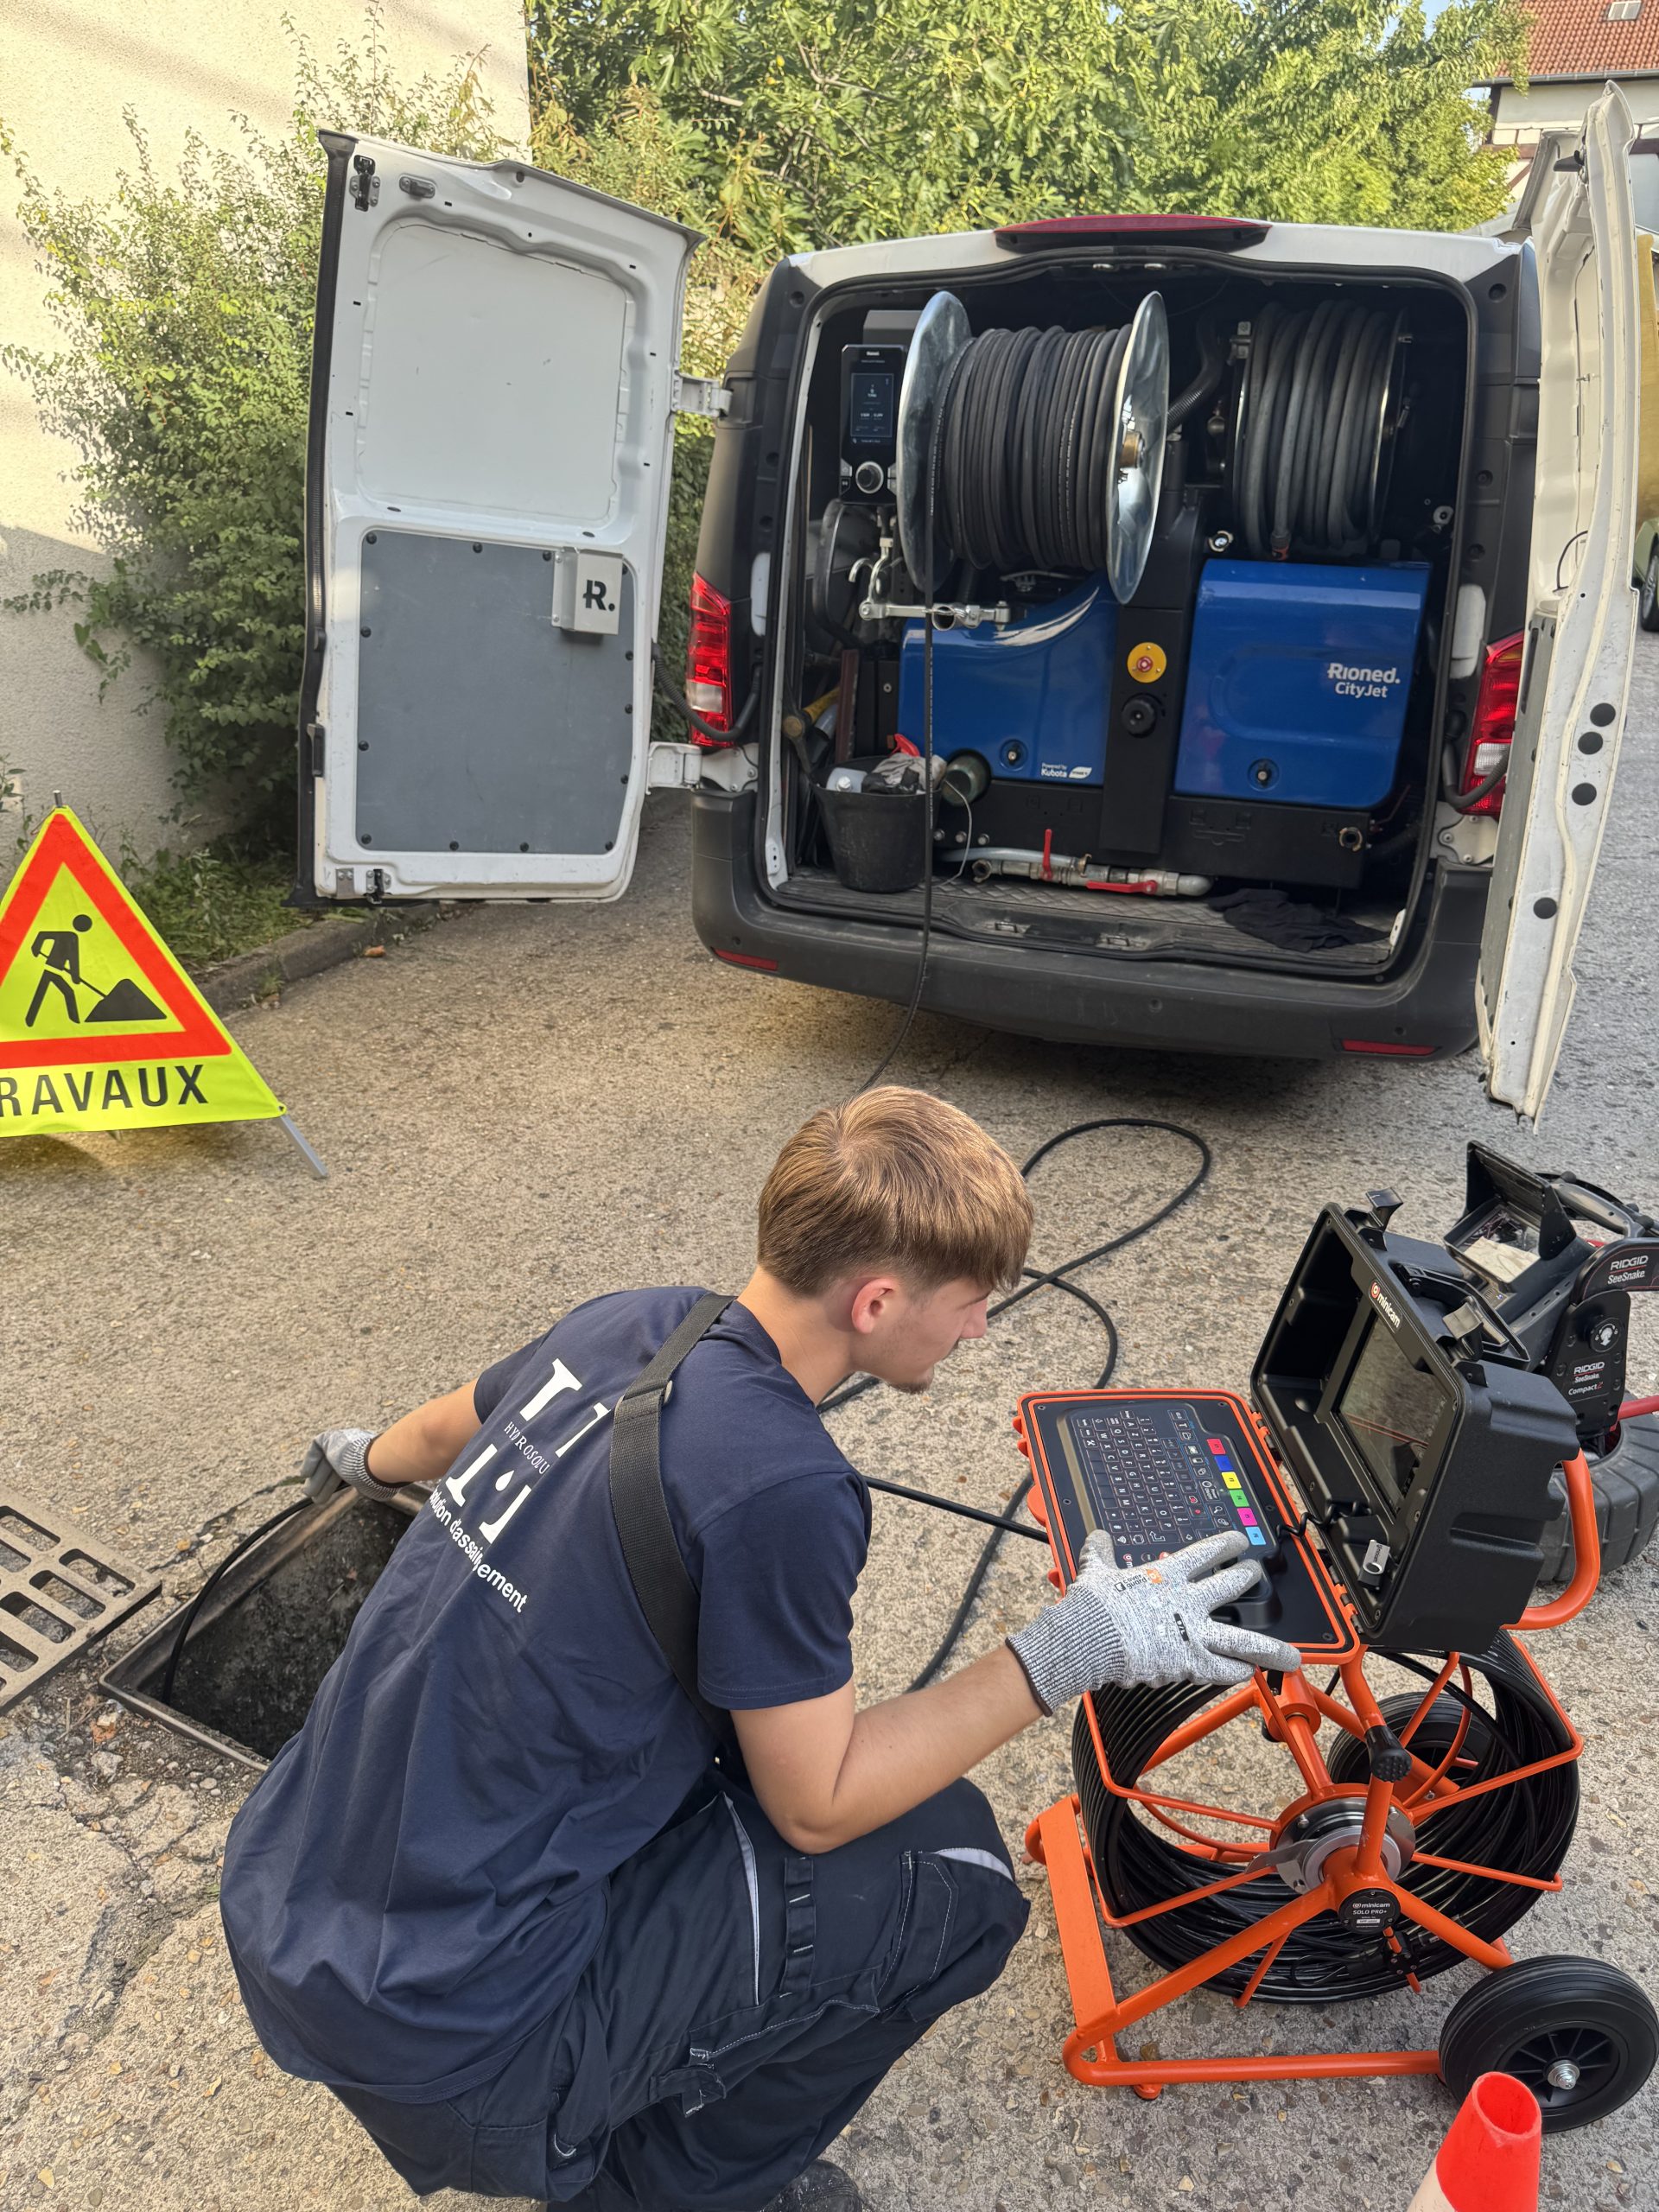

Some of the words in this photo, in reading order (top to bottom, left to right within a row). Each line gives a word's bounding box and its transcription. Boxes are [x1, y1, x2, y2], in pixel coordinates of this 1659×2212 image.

[1335, 683, 1388, 698] CityJet
[1041, 769, 1067, 778] Kubota
[0, 1064, 207, 1117] RAVAUX
[1611, 1255, 1649, 1270] RIDGID
[1608, 1270, 1645, 1284] SeeSnake
[1377, 1293, 1400, 1328] minicam
[1573, 1362, 1605, 1375] RIDGID
[504, 1421, 550, 1474] HYDROSOLU
[1127, 1577, 1147, 1589] guard
